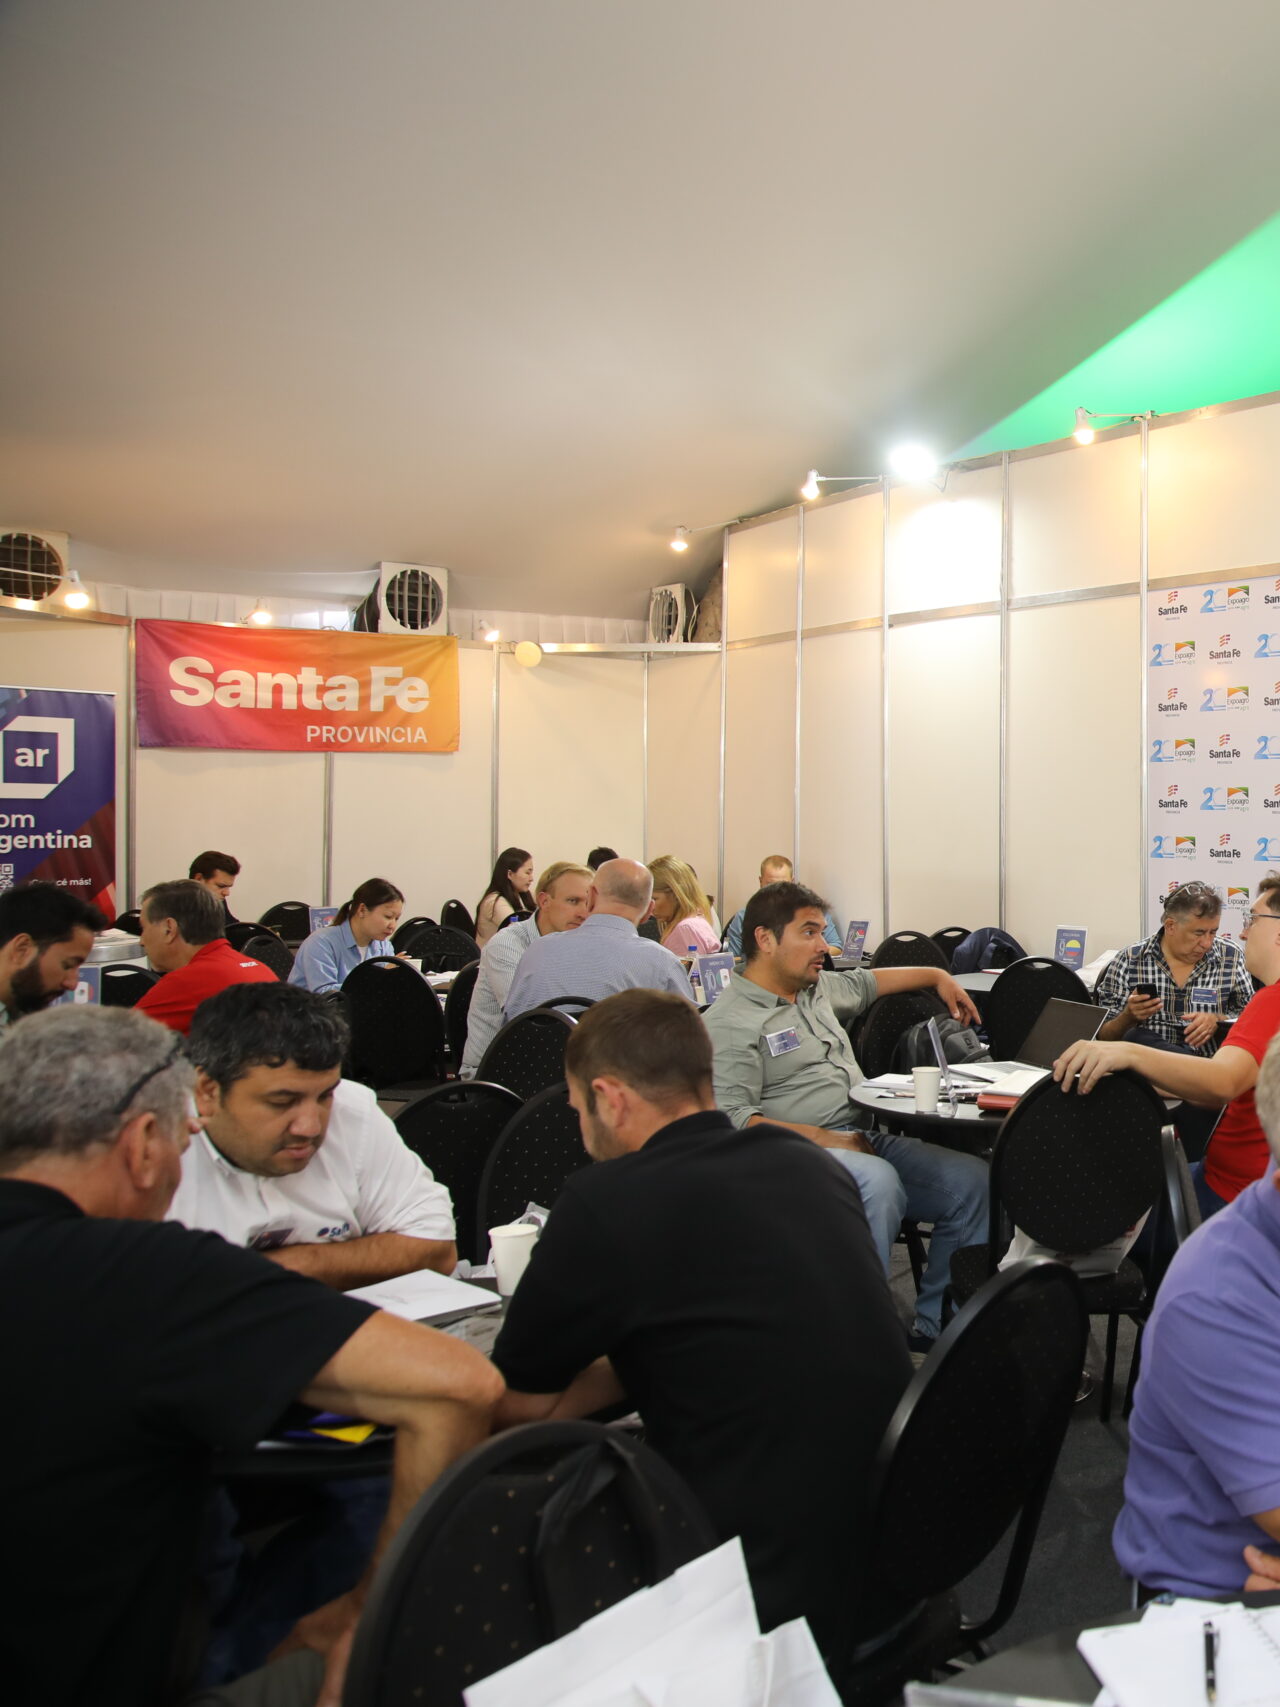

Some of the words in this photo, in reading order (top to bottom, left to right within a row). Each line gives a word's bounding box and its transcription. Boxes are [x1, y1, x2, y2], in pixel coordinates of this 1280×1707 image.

[1158, 606, 1178, 616] Santa
[1180, 605, 1187, 613] Fe
[1175, 652, 1195, 660] Expoagro
[1209, 650, 1230, 659] Santa
[1232, 649, 1240, 657] Fe
[170, 657, 359, 712] Santa
[370, 666, 430, 713] Fe
[1158, 704, 1178, 712] Santa
[1180, 702, 1187, 711] Fe
[307, 726, 427, 743] PROVINCIA
[15, 747, 50, 767] ar
[1209, 750, 1230, 758] Santa
[1232, 749, 1240, 758] Fe
[1159, 799, 1178, 808] Santa
[1180, 799, 1187, 808] Fe
[1210, 849, 1230, 858] Santa
[1232, 850, 1241, 858] Fe
